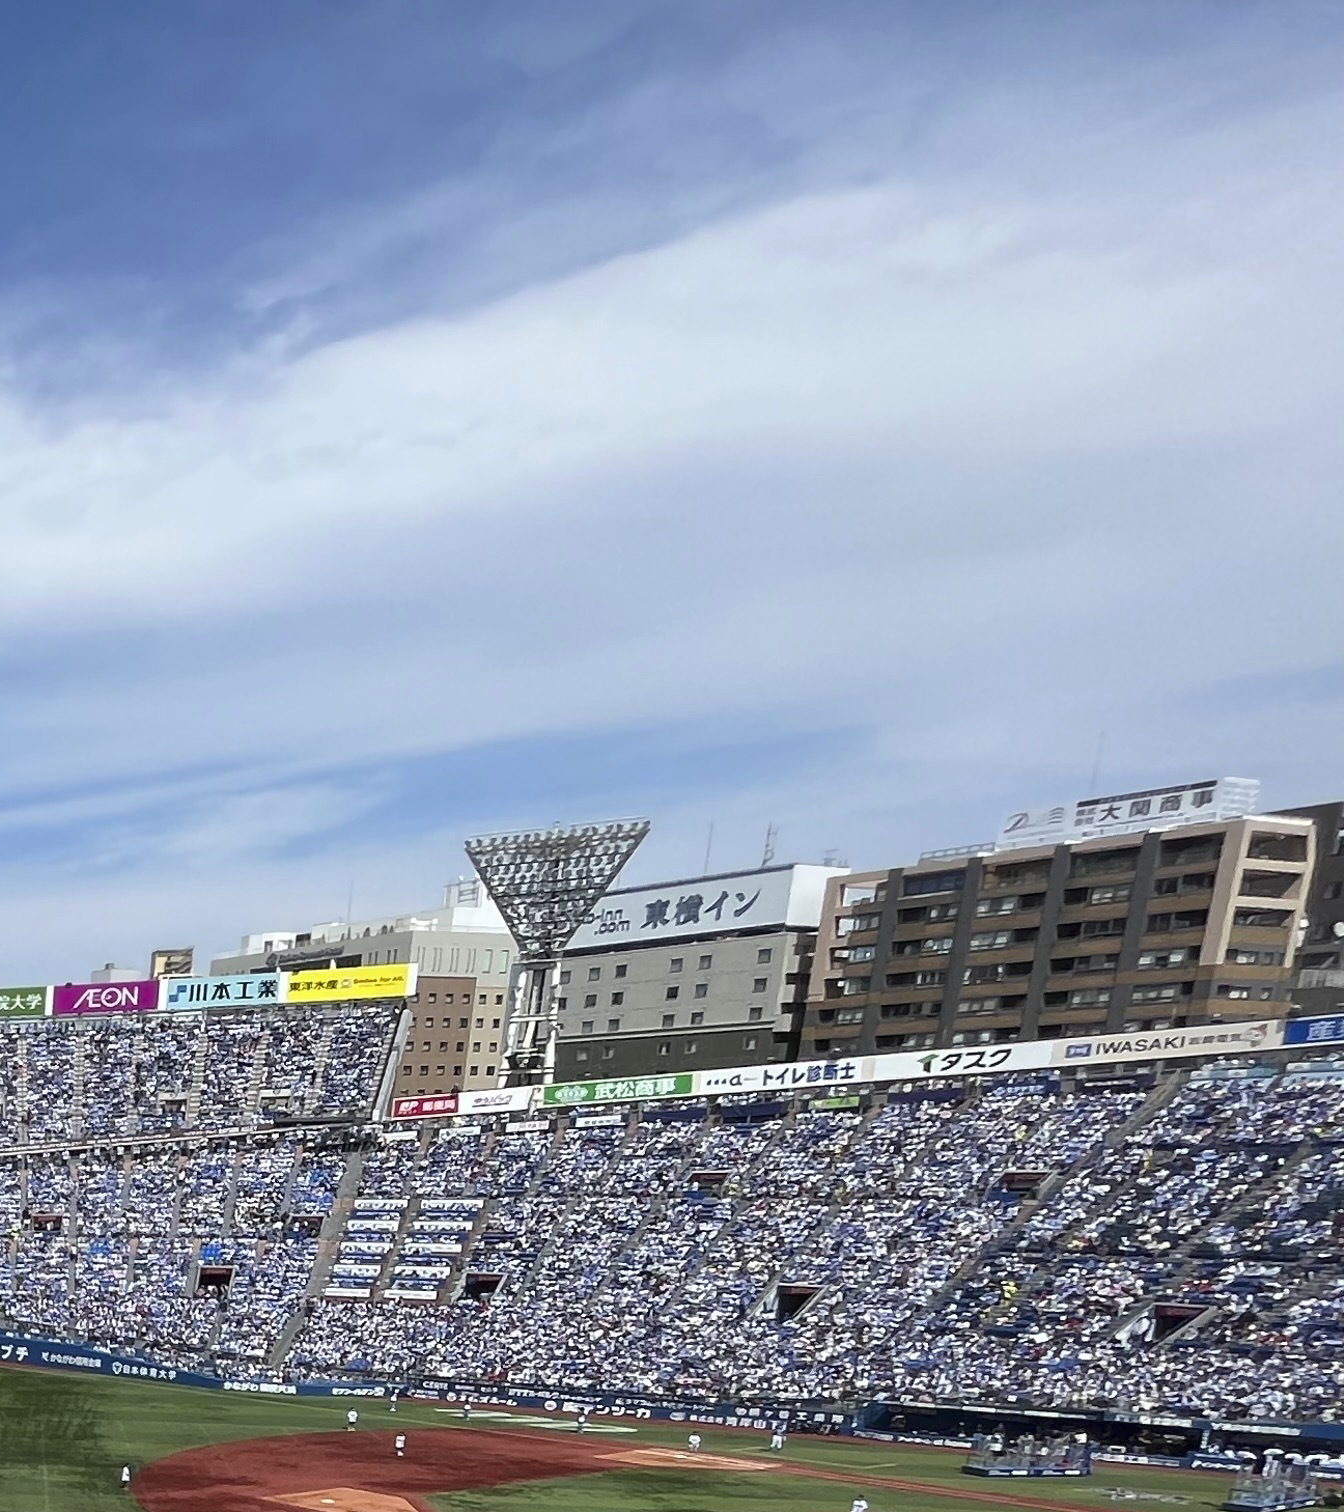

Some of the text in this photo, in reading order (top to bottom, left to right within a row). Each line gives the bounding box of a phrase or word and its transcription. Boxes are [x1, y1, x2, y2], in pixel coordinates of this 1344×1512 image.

[641, 888, 762, 929] 東横イン
[188, 979, 279, 1002] 川本工業
[1095, 1035, 1187, 1056] IWASAKI
[940, 1048, 1013, 1071] タスク
